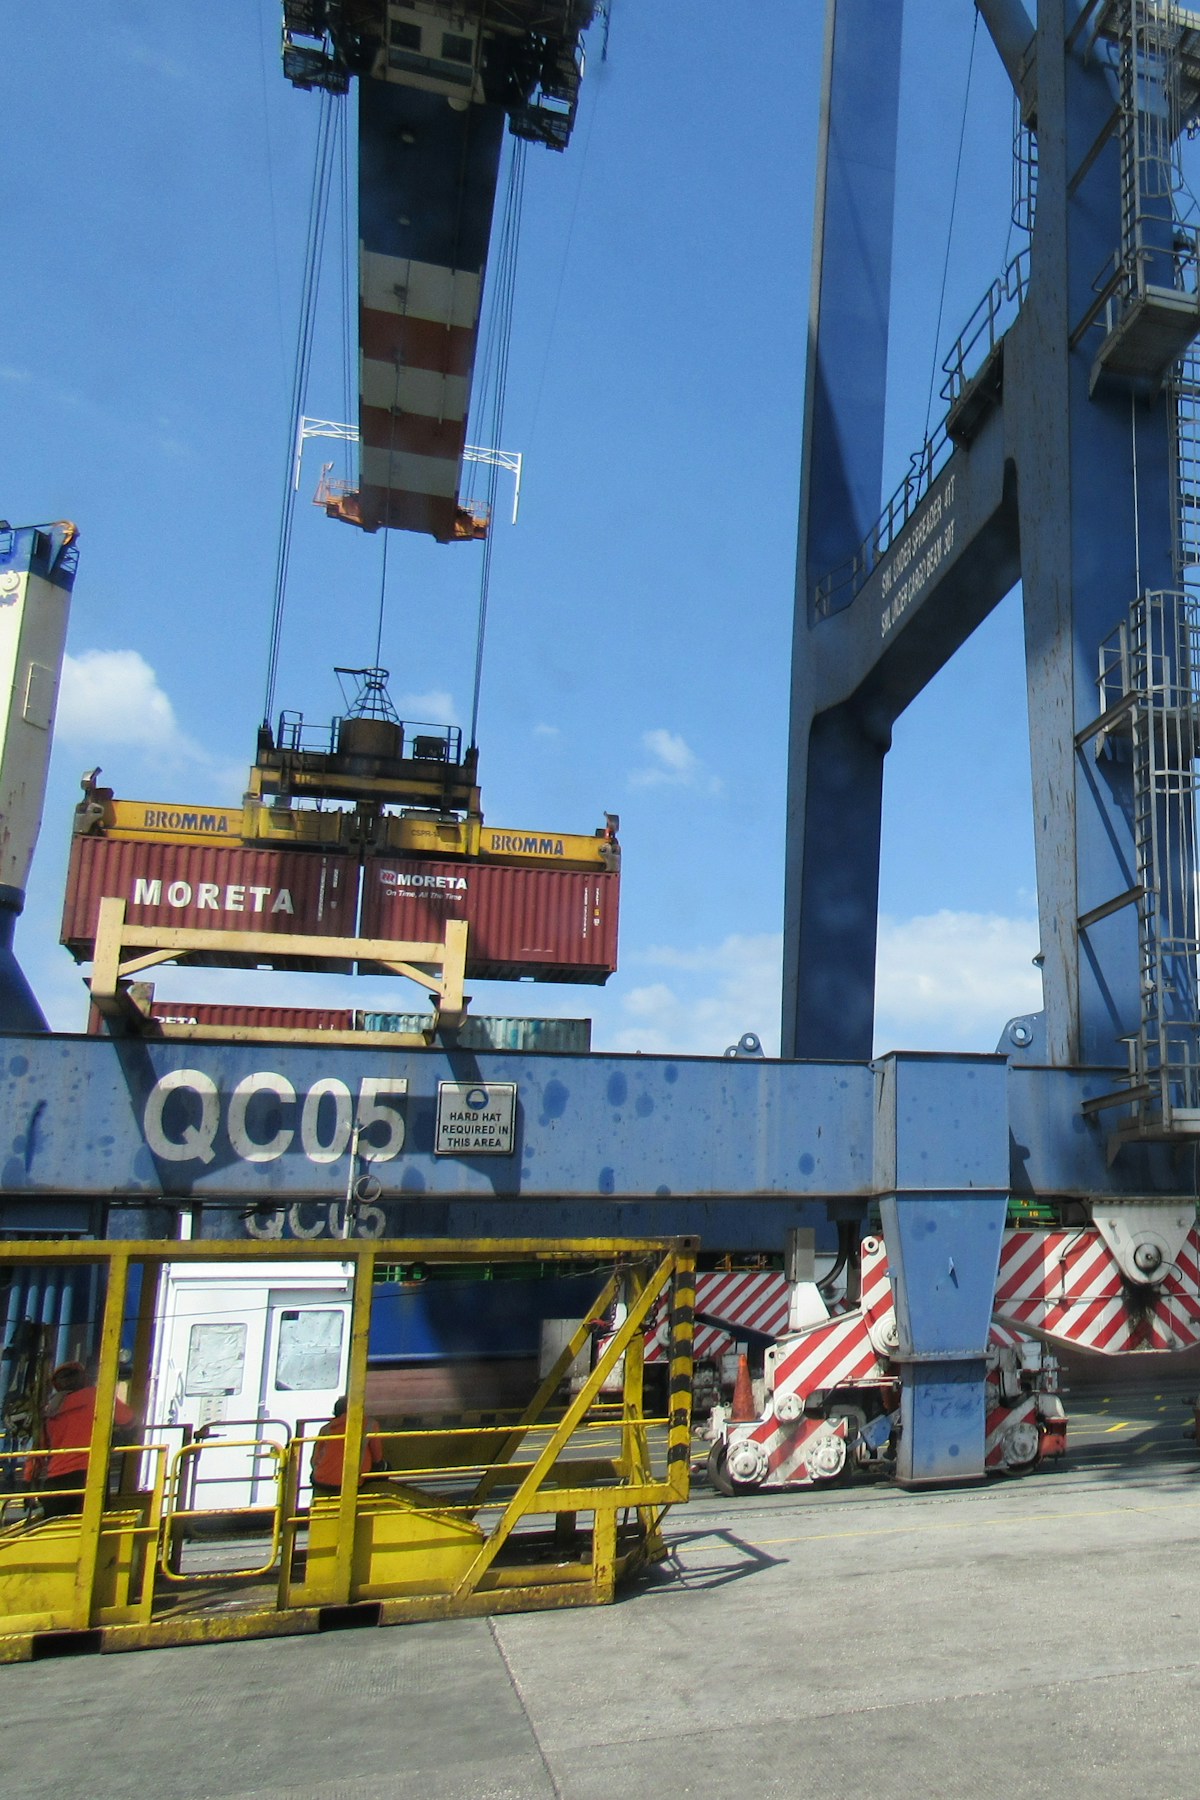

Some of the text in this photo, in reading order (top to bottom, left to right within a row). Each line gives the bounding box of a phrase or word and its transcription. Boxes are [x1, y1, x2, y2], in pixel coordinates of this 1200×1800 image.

[144, 810, 229, 833] BROMMA
[491, 834, 564, 855] BROMMA
[397, 873, 468, 890] MORETA
[133, 878, 294, 914] MORETA
[445, 893, 463, 901] Time
[144, 1068, 408, 1165] QC05
[449, 1112, 502, 1122] HARD HAT
[442, 1125, 509, 1135] REQUIRED IN
[447, 1138, 502, 1147] THIS AREA
